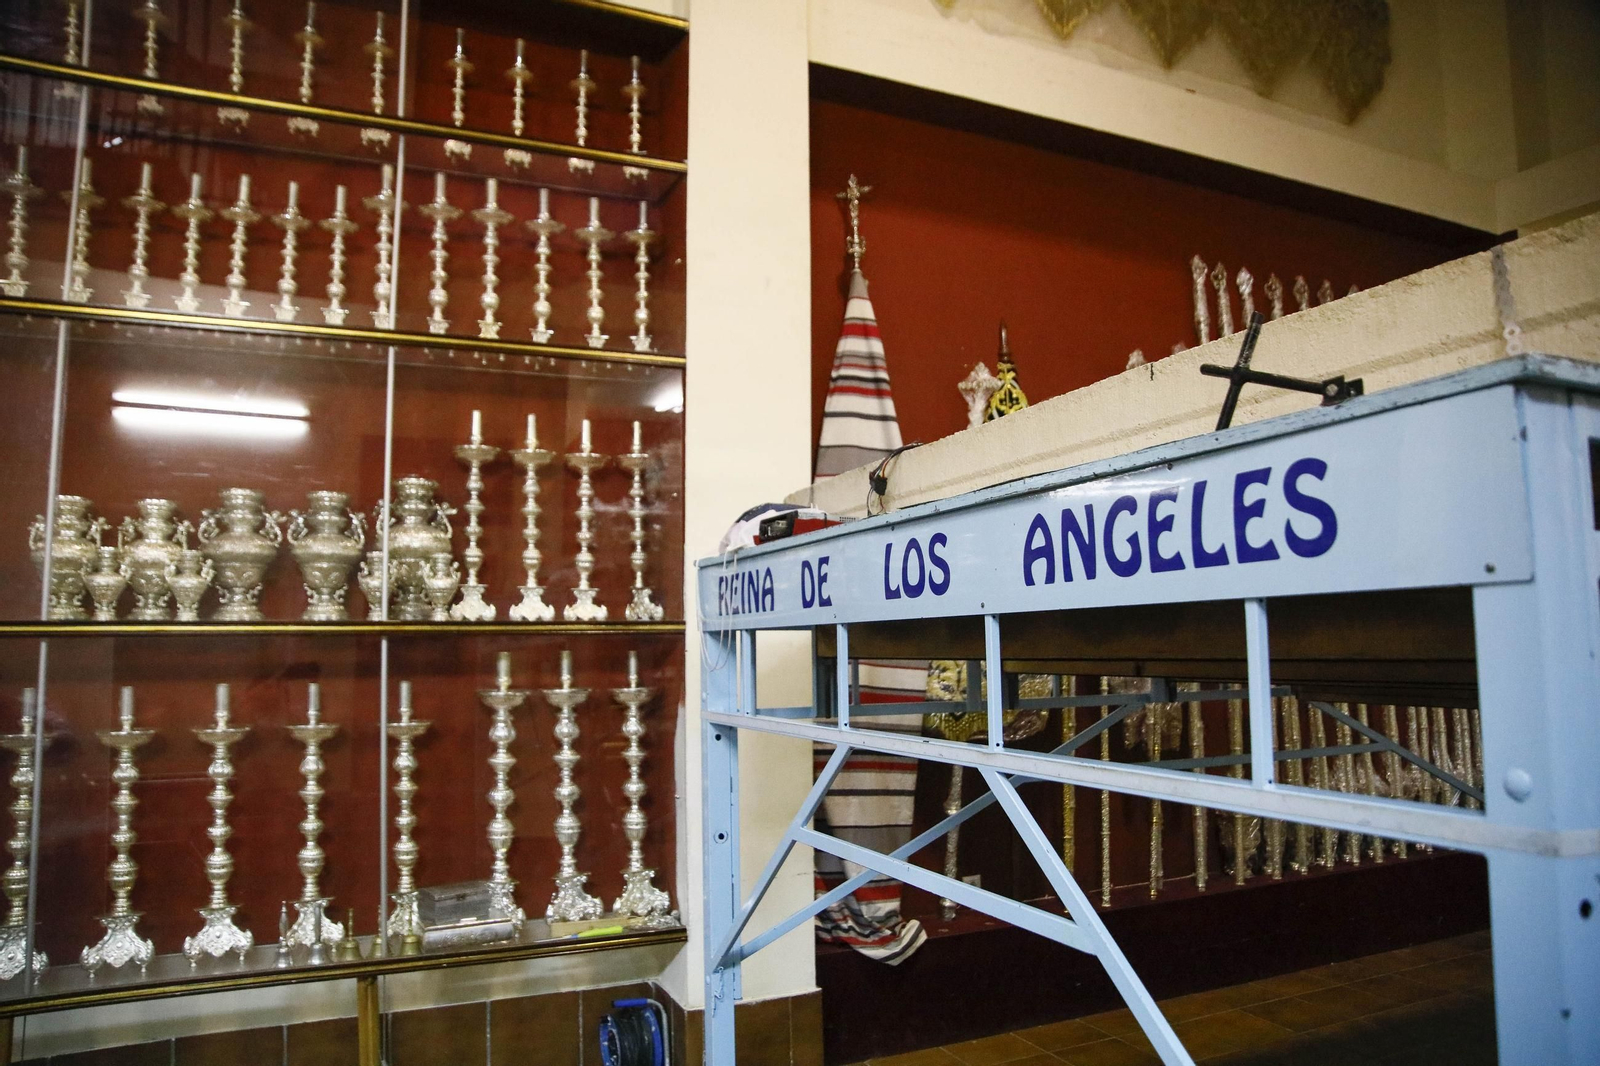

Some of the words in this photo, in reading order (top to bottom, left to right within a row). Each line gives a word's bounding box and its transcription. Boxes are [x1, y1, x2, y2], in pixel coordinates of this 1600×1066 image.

[718, 567, 775, 616] REINA
[801, 556, 832, 609] DE
[885, 533, 951, 600] LOS
[1023, 458, 1338, 586] ANGELES
